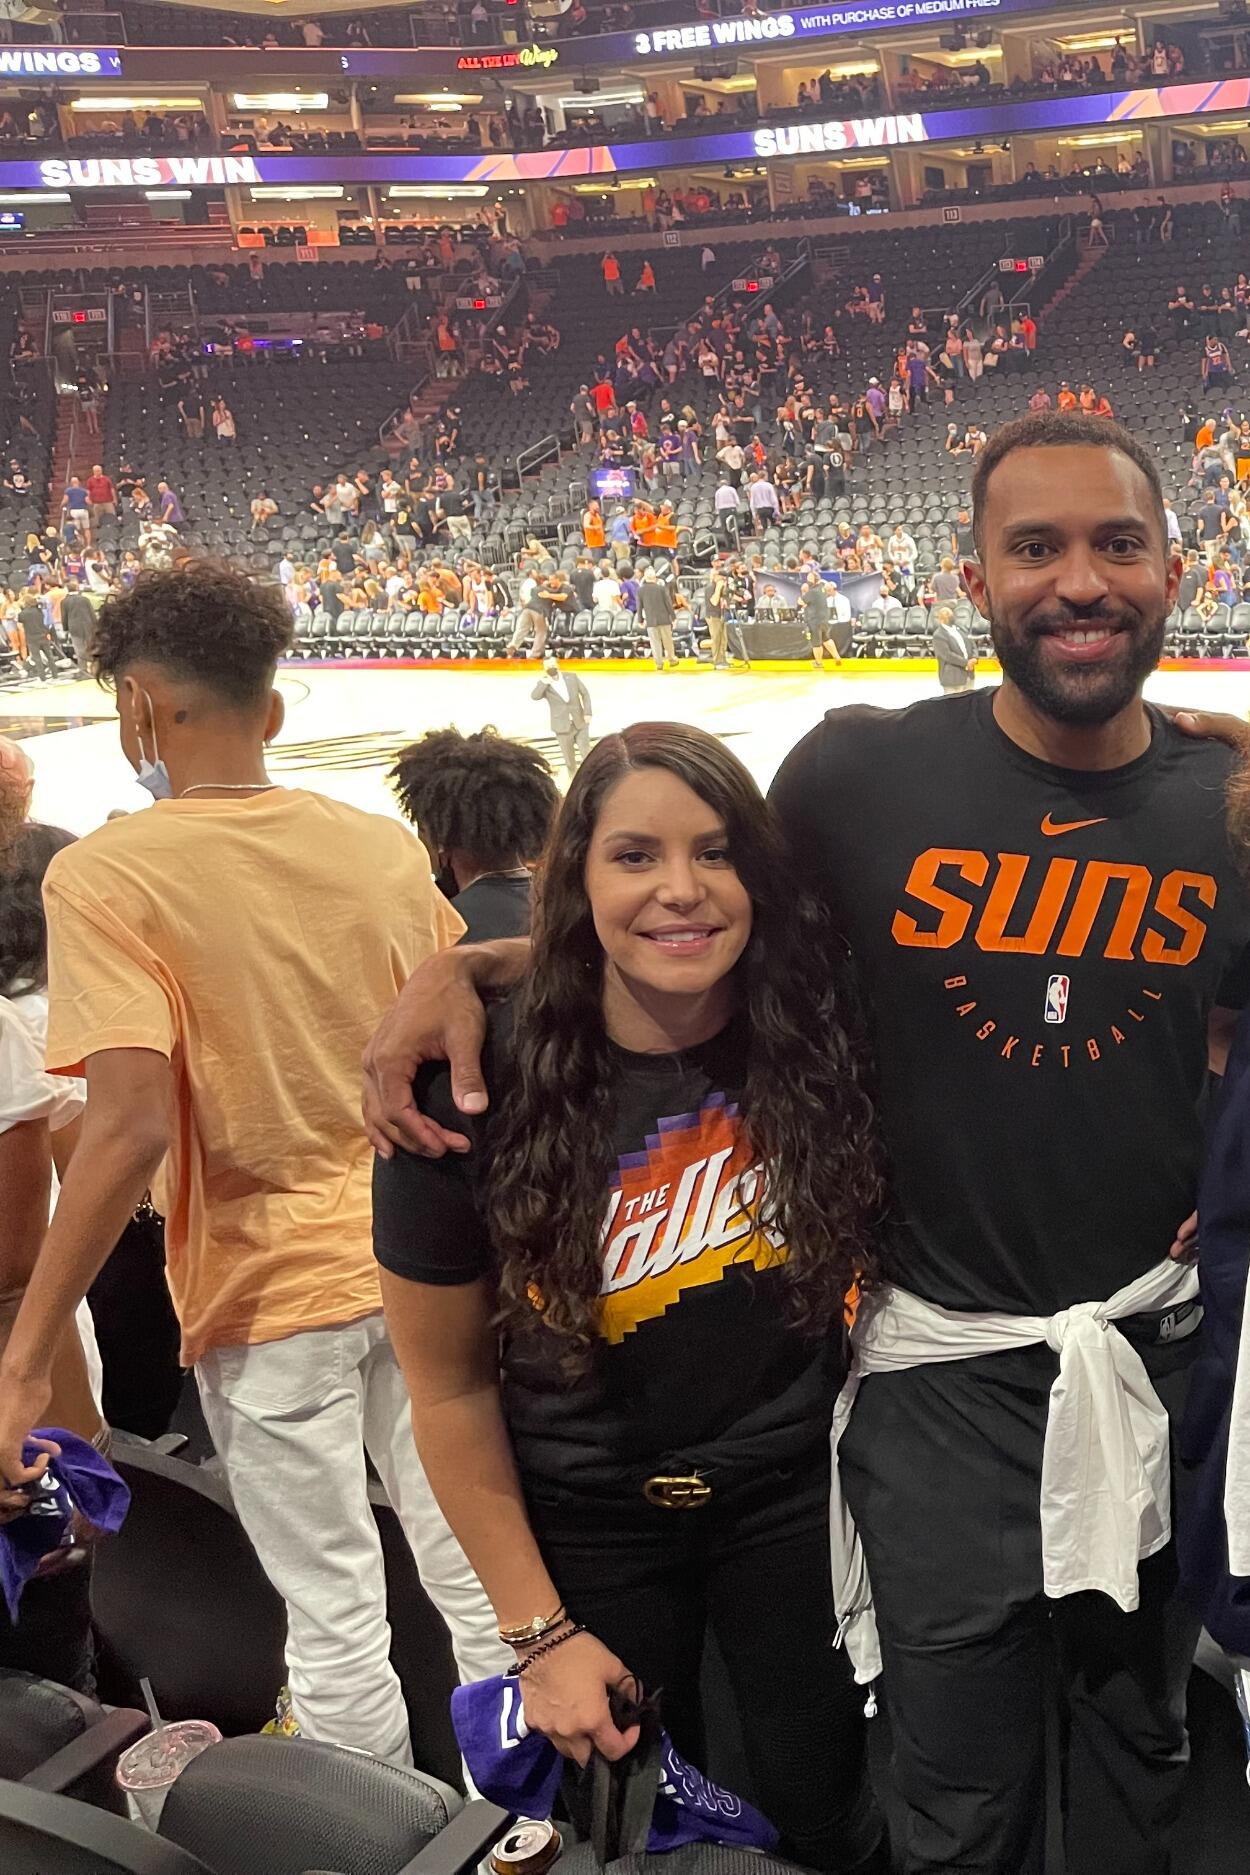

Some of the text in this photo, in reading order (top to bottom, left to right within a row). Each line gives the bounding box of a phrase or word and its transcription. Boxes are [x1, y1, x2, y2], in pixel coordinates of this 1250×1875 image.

[635, 14, 795, 54] 3 FREE WINGS
[801, 14, 832, 29] WITH
[832, 9, 896, 25] PURCHASE
[896, 5, 914, 18] OF
[915, 0, 964, 14] MEDIUM
[0, 52, 101, 73] WINGS
[753, 113, 926, 156] SUNS WIN
[39, 156, 255, 187] SUNS WIN
[890, 846, 1218, 967] SUNS
[944, 973, 1163, 1069] BASKETBALL
[625, 1183, 672, 1222] THE
